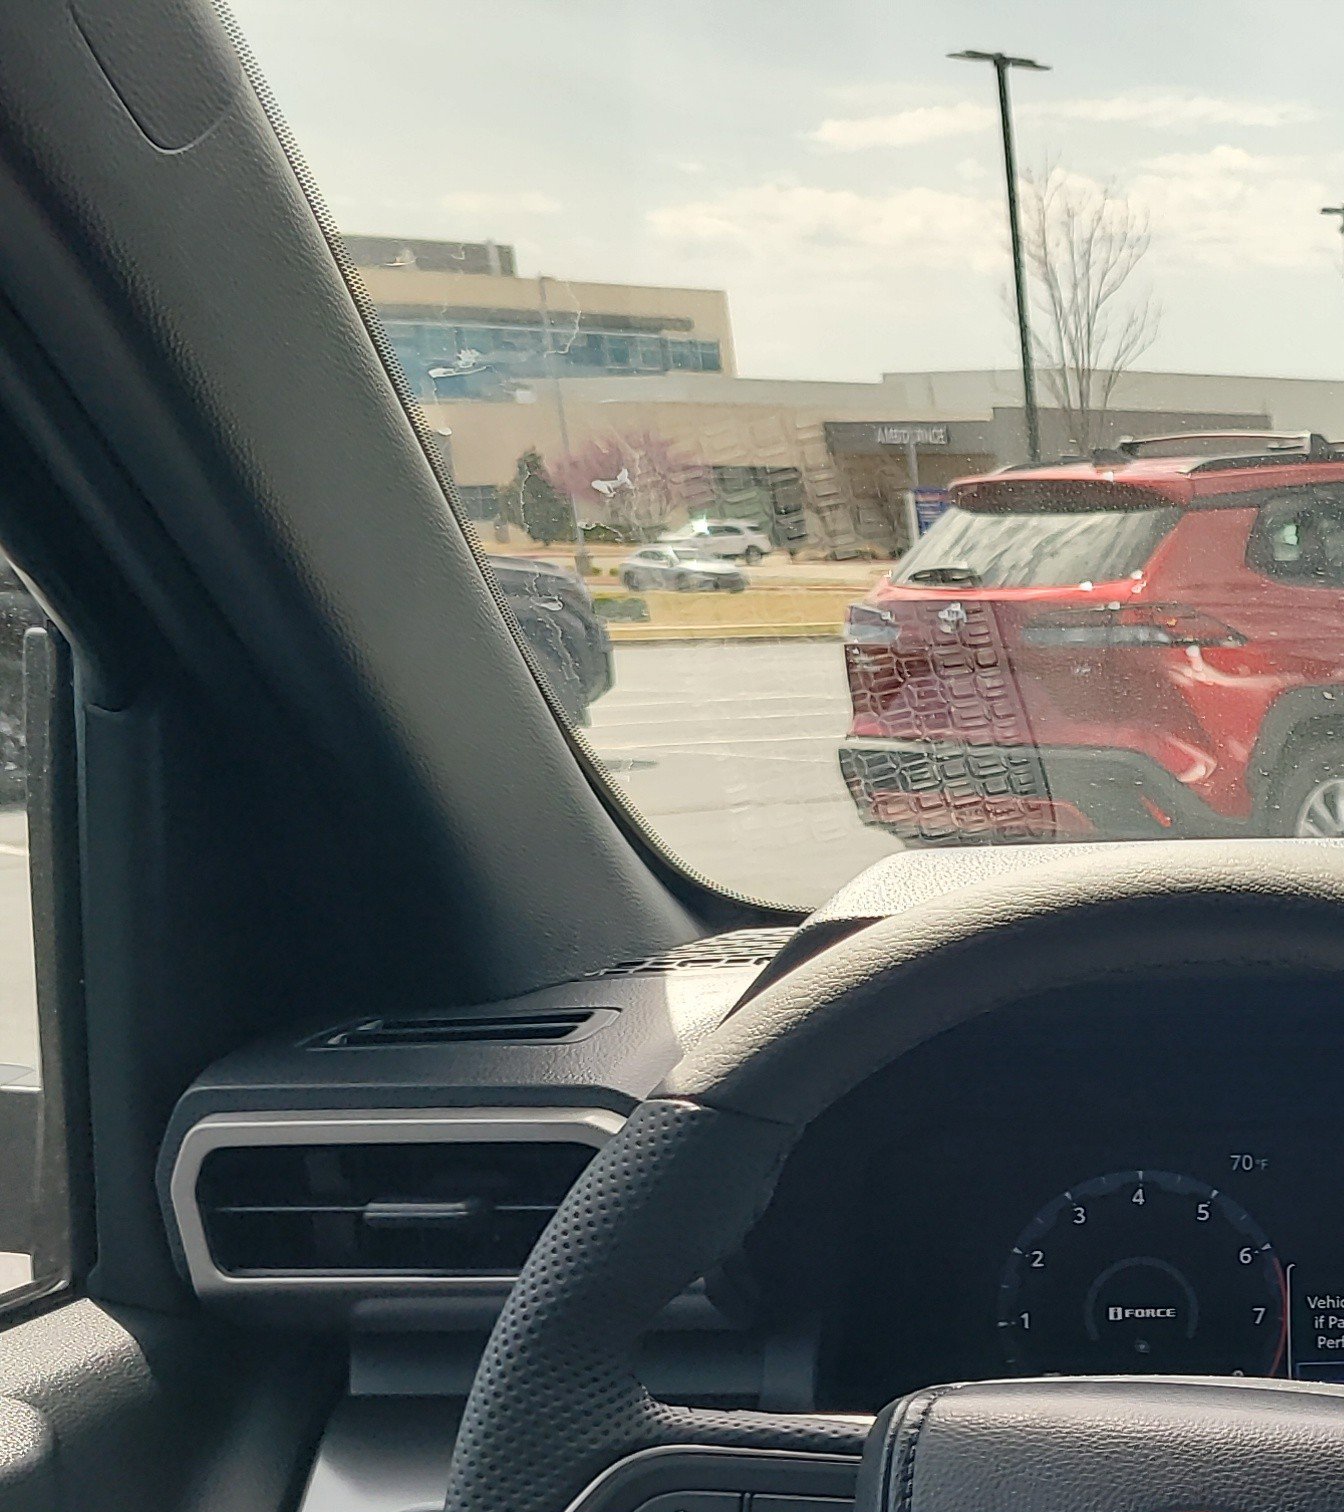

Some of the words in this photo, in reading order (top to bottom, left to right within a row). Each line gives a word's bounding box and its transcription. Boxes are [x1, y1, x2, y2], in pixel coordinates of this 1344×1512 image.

[1132, 1189, 1145, 1205] 4
[1073, 1207, 1086, 1224] 3
[1197, 1204, 1210, 1221] 5
[1031, 1250, 1044, 1267] 2
[1239, 1247, 1252, 1264] 6
[1020, 1312, 1030, 1329] 1
[1124, 1308, 1177, 1318] FORCE
[1252, 1308, 1266, 1325] 7
[1314, 1315, 1325, 1329] if
